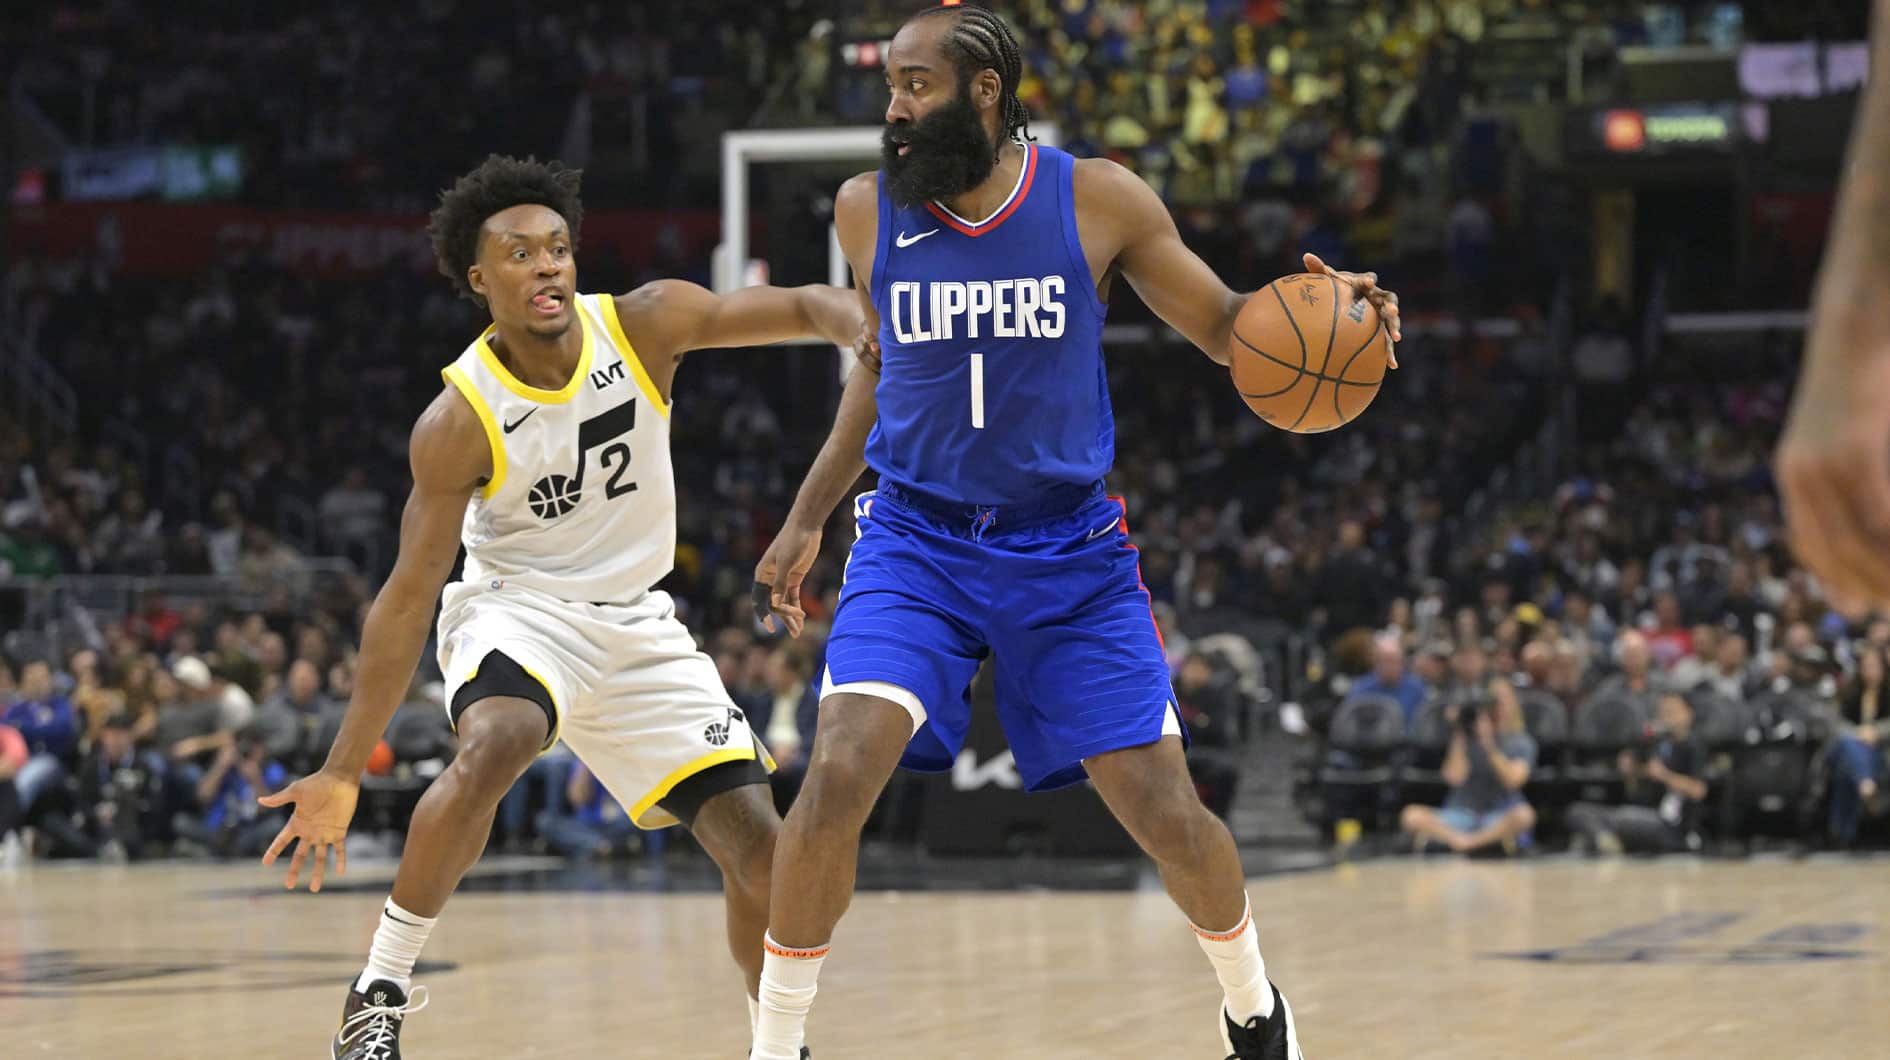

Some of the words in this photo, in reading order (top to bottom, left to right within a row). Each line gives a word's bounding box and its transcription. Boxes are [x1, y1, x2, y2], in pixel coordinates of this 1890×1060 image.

[890, 275, 1066, 344] CLIPPERS
[591, 360, 624, 390] LVT
[970, 353, 985, 428] 1
[601, 442, 638, 500] 2
